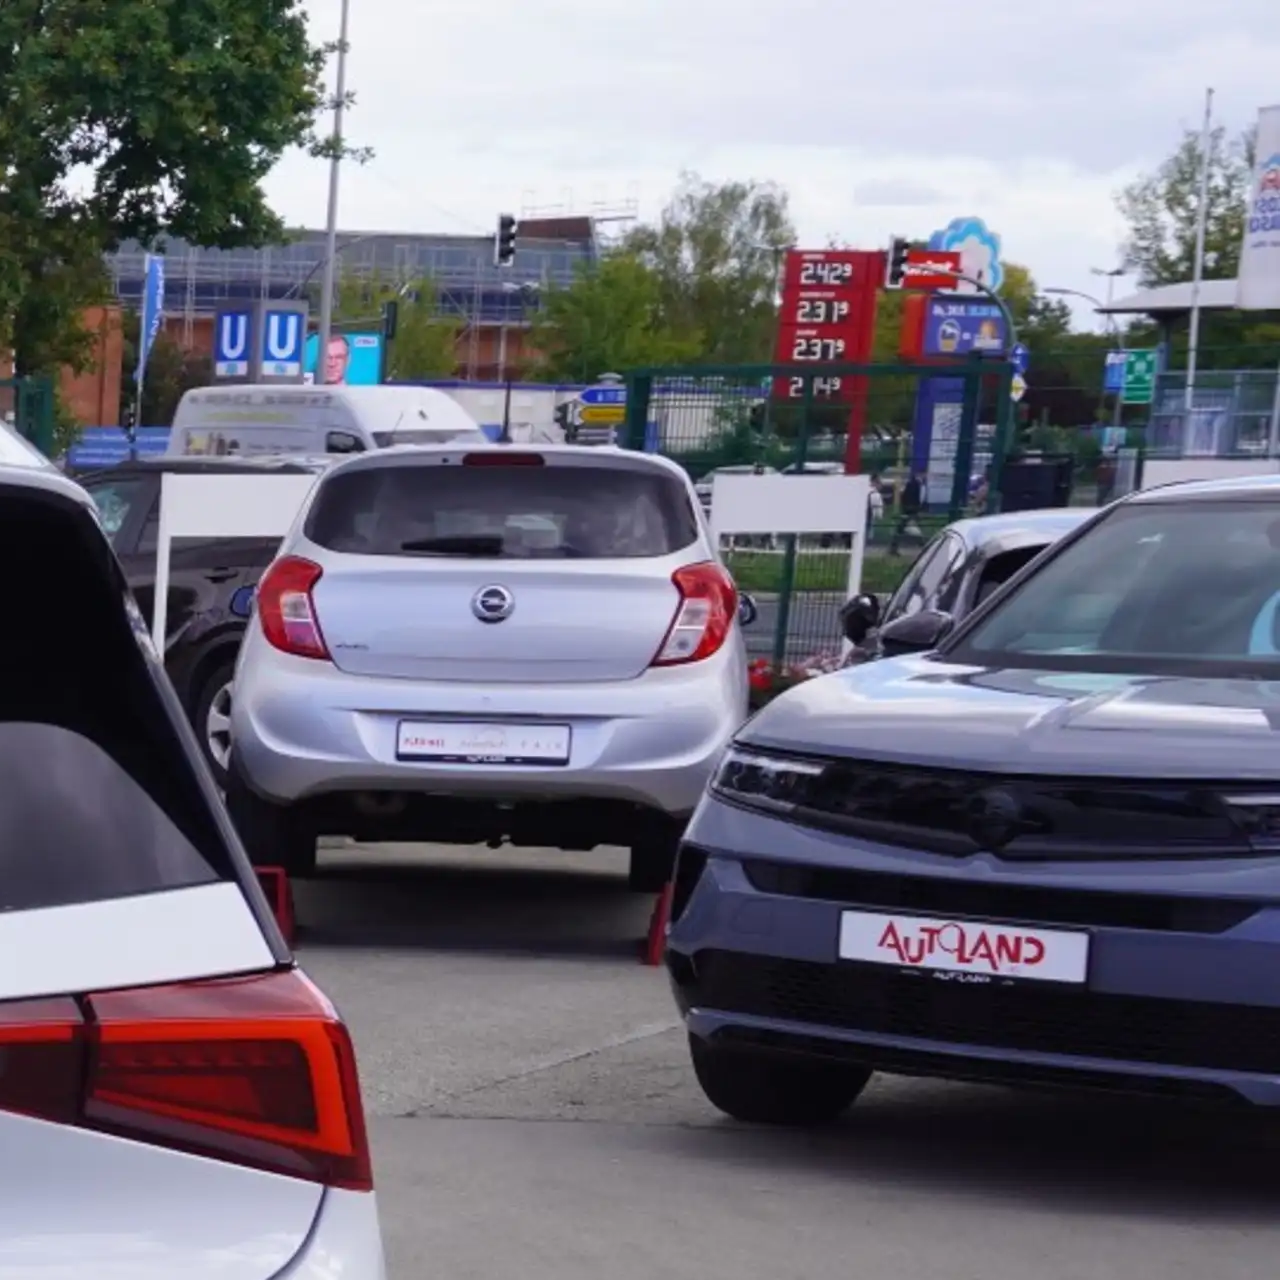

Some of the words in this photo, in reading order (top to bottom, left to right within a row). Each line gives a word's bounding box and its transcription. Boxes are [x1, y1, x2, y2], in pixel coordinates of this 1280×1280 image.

[221, 315, 247, 360] U
[268, 314, 298, 360] U
[877, 919, 1046, 972] AUTOLAND
